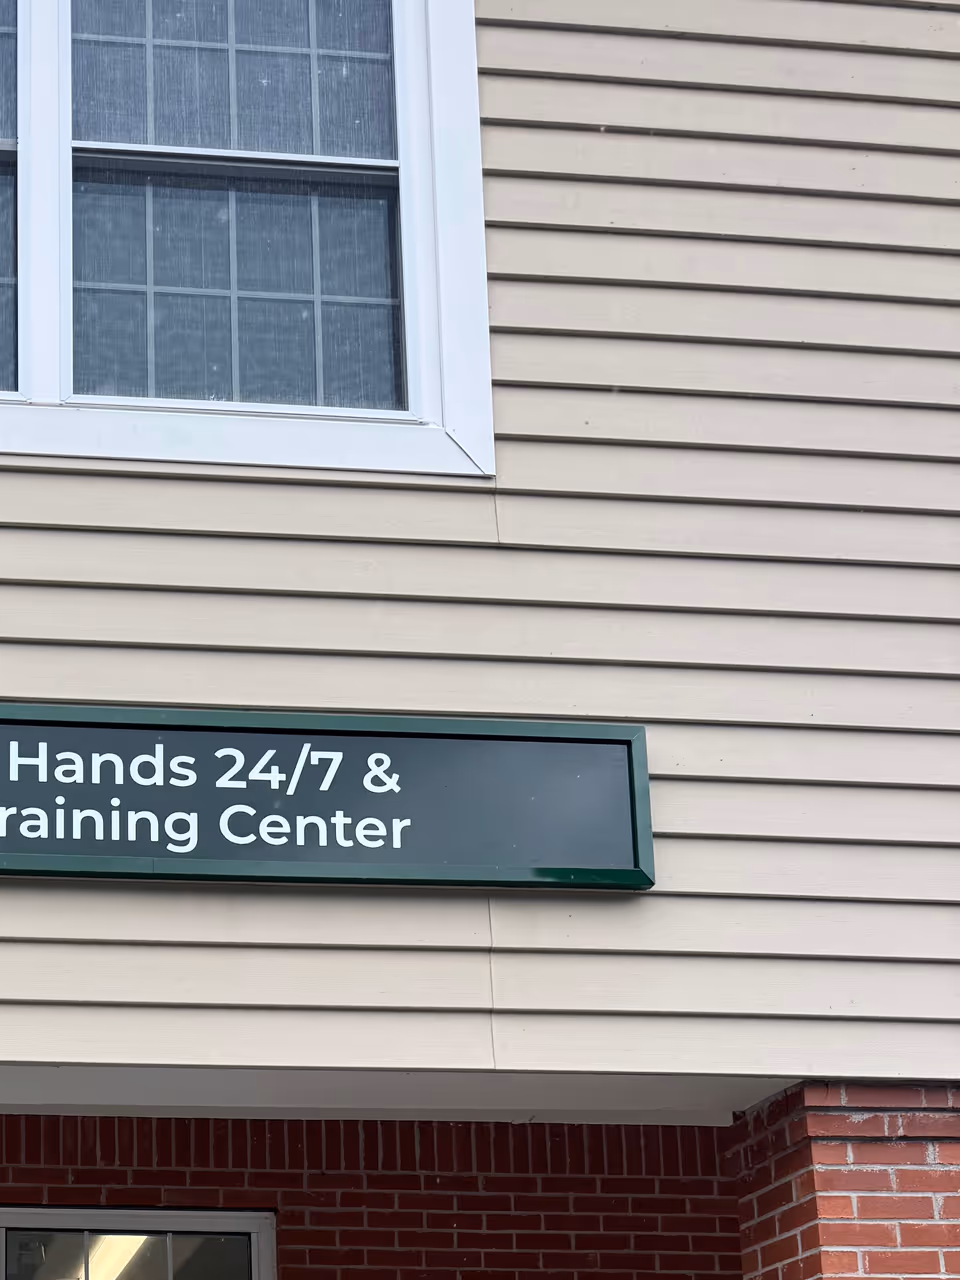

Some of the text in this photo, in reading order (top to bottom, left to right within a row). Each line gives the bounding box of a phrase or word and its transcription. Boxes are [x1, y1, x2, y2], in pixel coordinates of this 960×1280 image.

[9, 741, 198, 788] Hands
[215, 747, 344, 795] 24/7
[362, 753, 402, 795] &
[218, 805, 412, 850] Center
